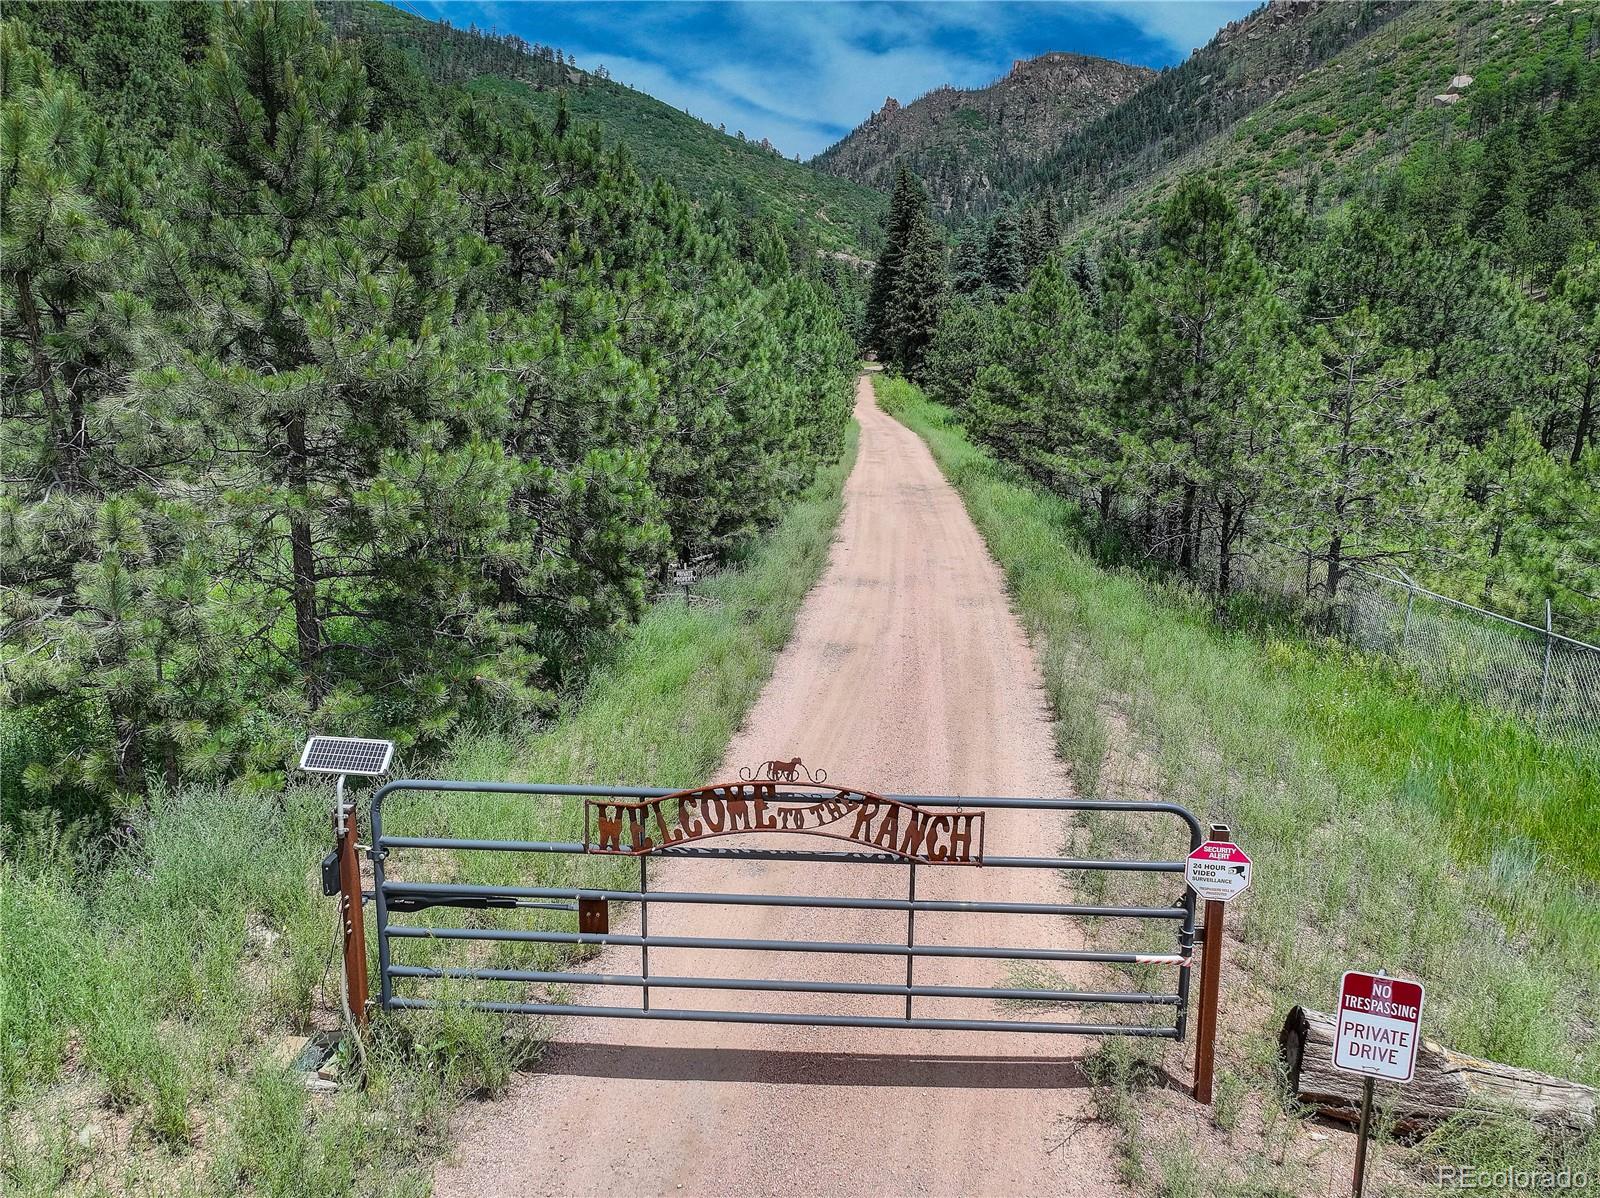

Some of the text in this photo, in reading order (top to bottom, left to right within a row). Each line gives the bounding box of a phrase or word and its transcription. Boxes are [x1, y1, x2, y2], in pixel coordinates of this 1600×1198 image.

[598, 784, 974, 862] WELCOME TO THE RANCH
[1203, 846, 1237, 854] SECURITY
[1192, 876, 1232, 884] SURVEILLANCE
[1372, 983, 1392, 999] NO
[1344, 994, 1418, 1020] TRESPASSING
[1343, 1021, 1410, 1048] PRIVATE
[1349, 1041, 1399, 1065] DRIVE
